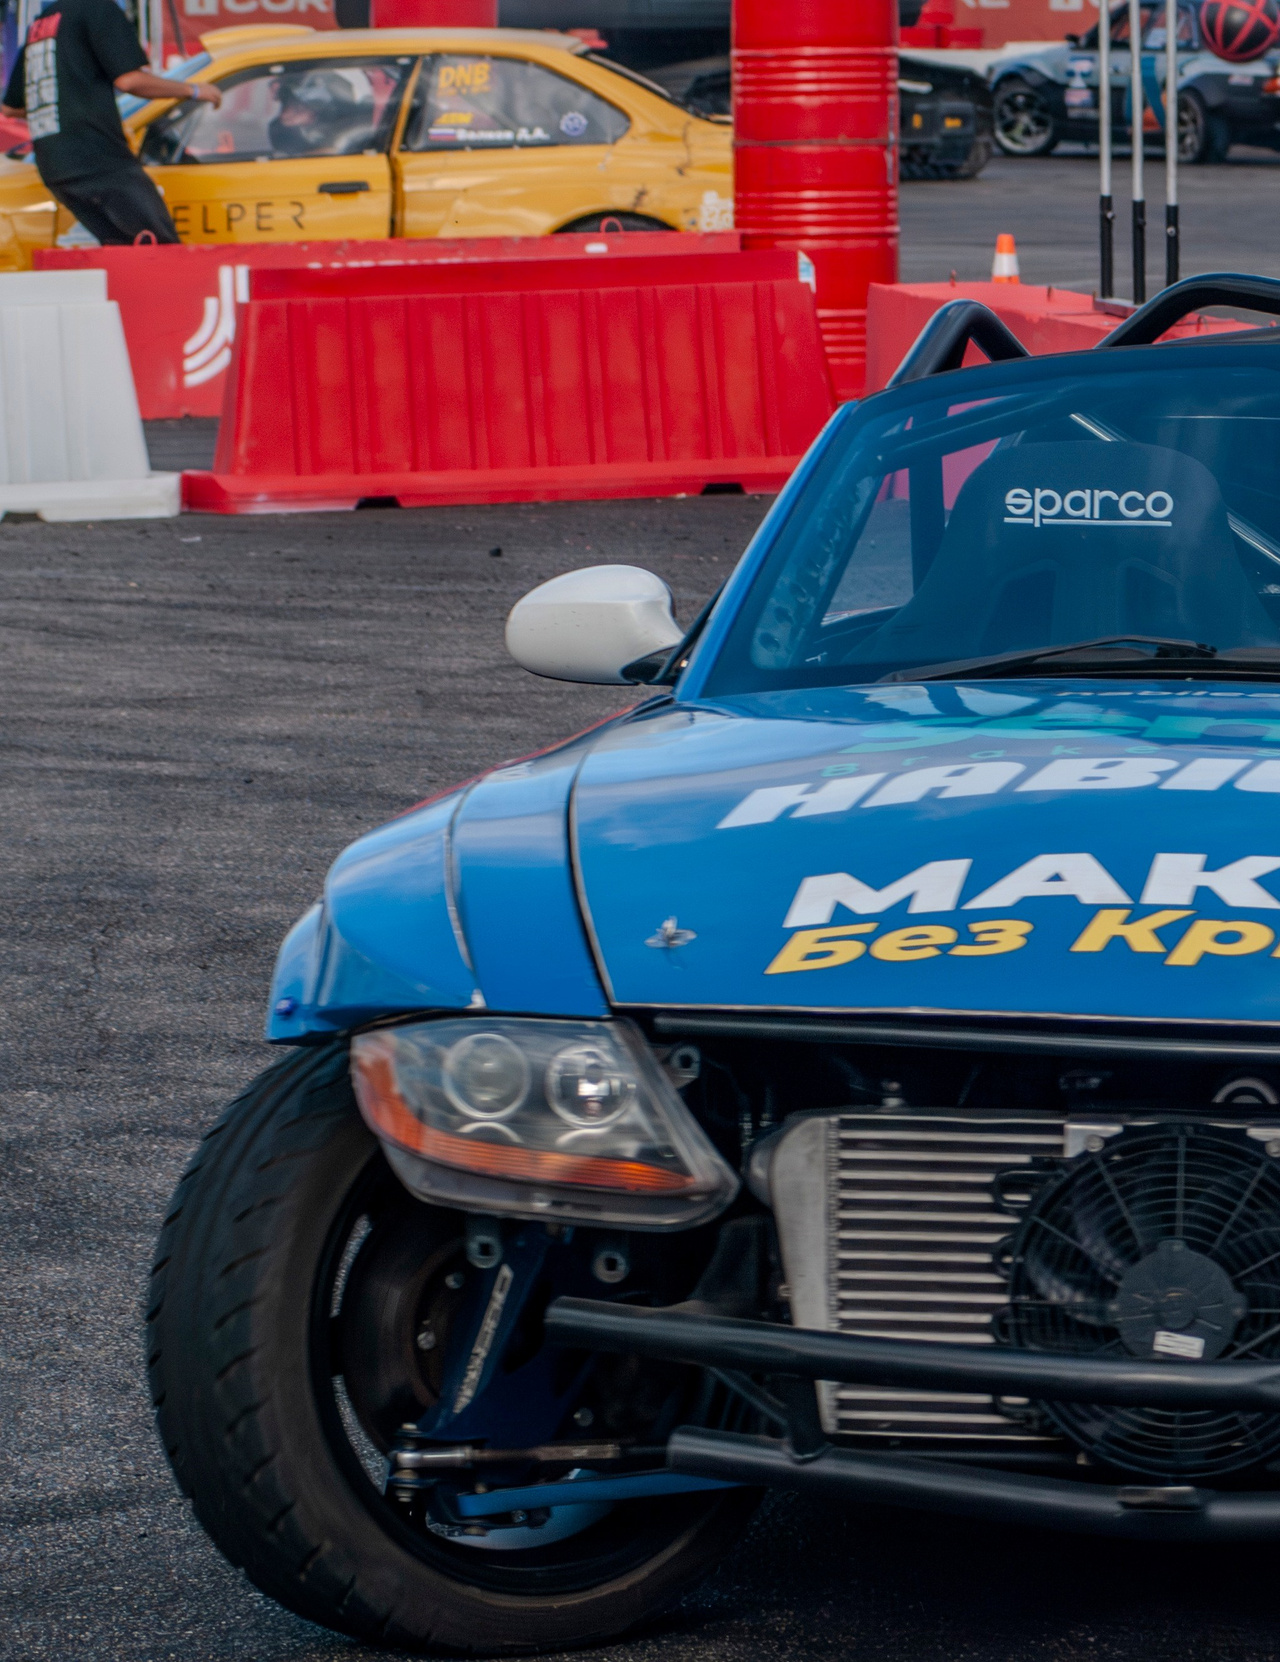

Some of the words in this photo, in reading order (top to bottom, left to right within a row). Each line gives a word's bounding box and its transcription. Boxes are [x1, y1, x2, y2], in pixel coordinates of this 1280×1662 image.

[439, 62, 491, 89] DNB
[1004, 487, 1174, 528] sparco
[763, 919, 1035, 975] Без
